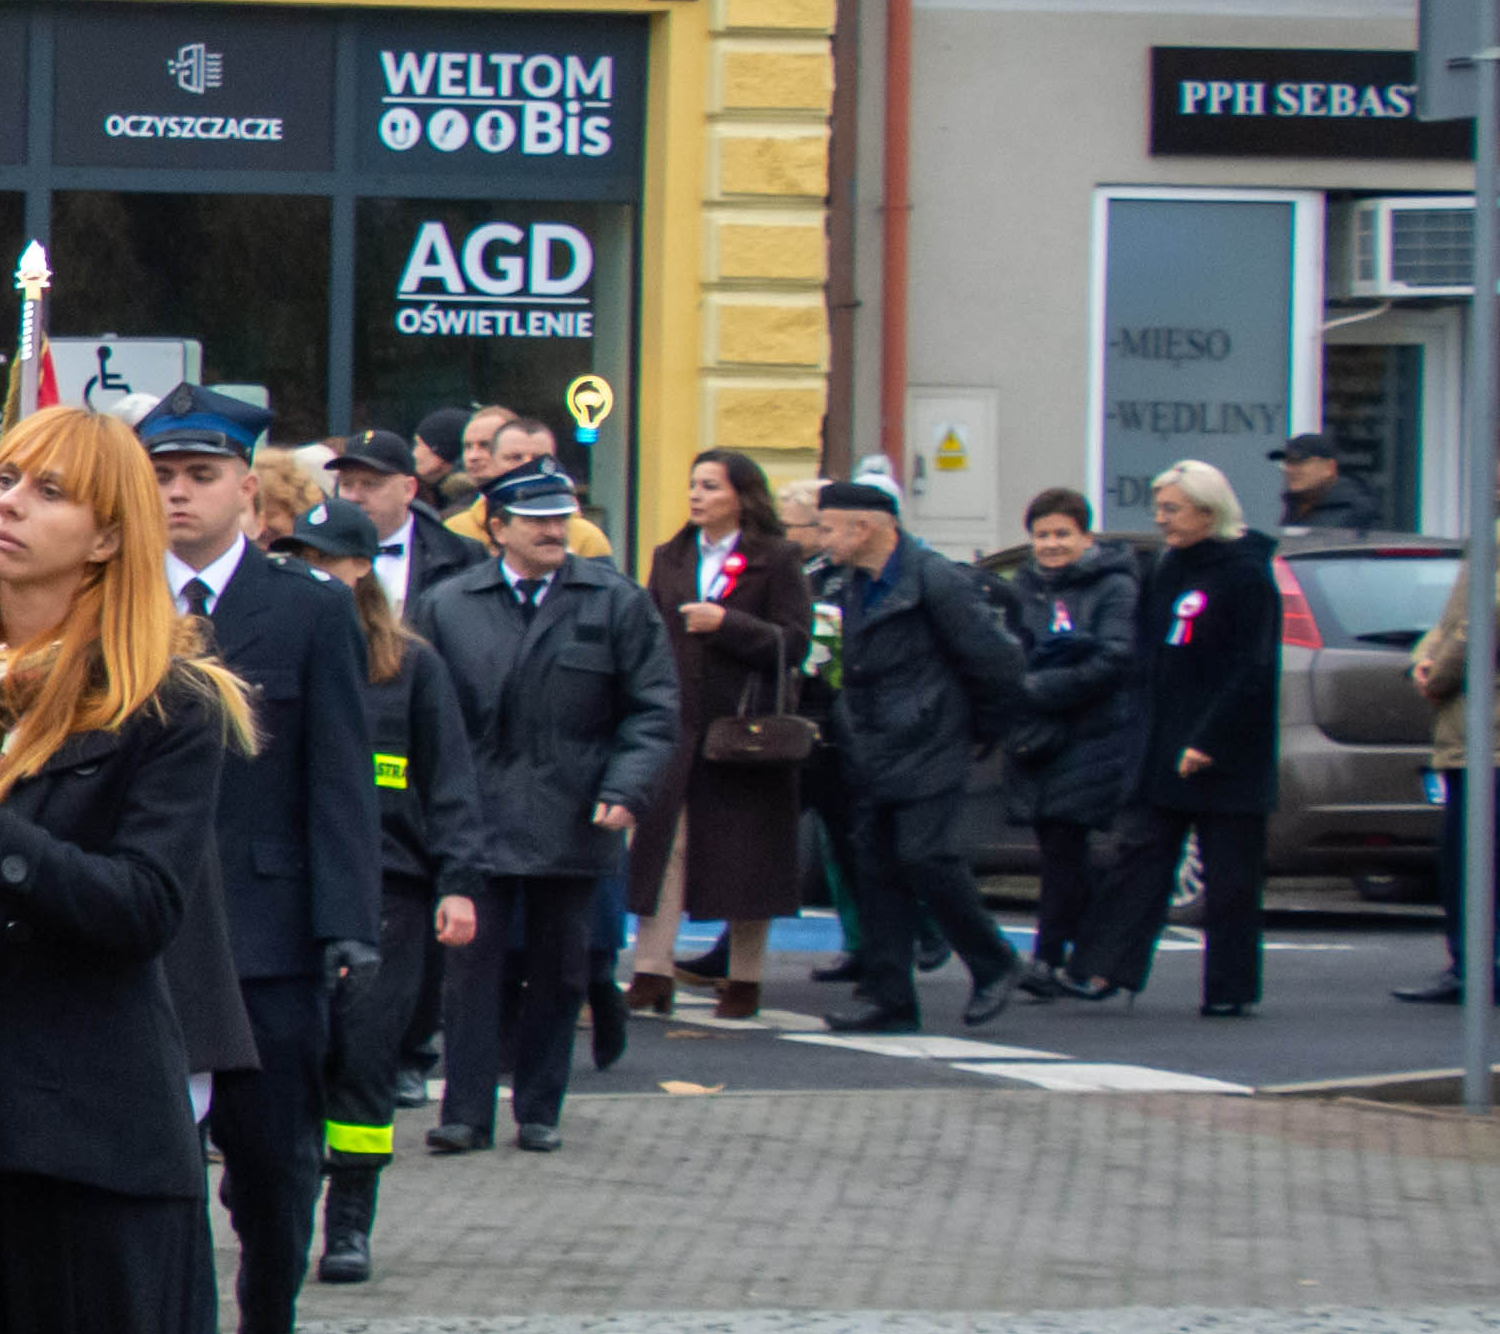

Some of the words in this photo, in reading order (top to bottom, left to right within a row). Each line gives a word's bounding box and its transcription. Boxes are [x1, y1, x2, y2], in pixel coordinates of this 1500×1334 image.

[380, 51, 613, 99] WELTOM
[1178, 80, 1266, 115] PPH
[1274, 83, 1419, 117] SEBAS
[105, 115, 283, 140] OCZYSZCZACZE
[523, 100, 612, 156] Bis
[398, 222, 594, 296] AGD
[396, 304, 594, 338] OŚWIETLENIE
[375, 762, 406, 779] STR
